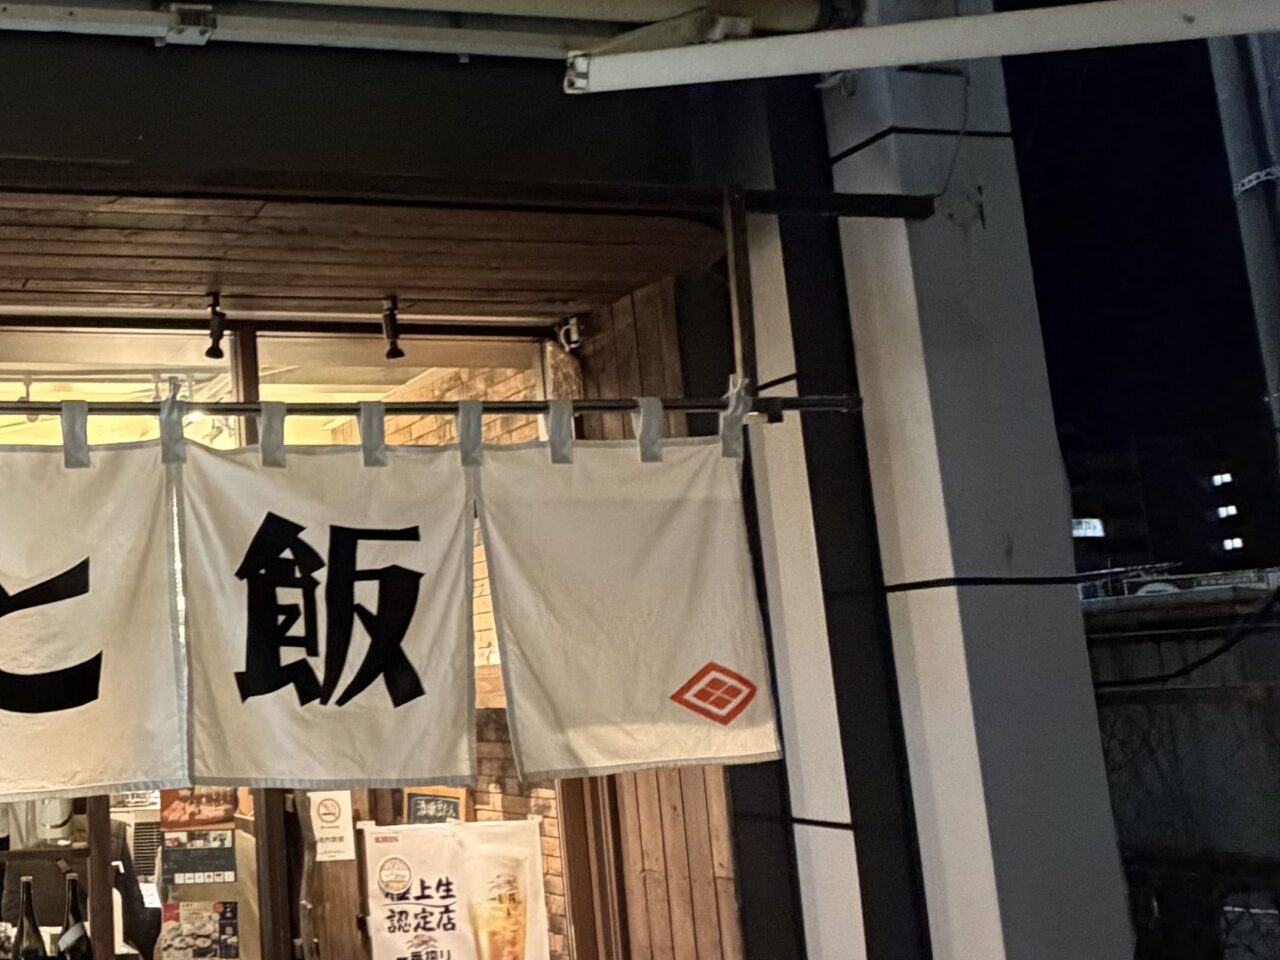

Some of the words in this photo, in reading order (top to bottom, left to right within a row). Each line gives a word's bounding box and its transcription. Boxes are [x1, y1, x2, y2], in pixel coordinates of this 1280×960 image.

[375, 835, 400, 844] KIRIN
[384, 906, 458, 934] 認定店
